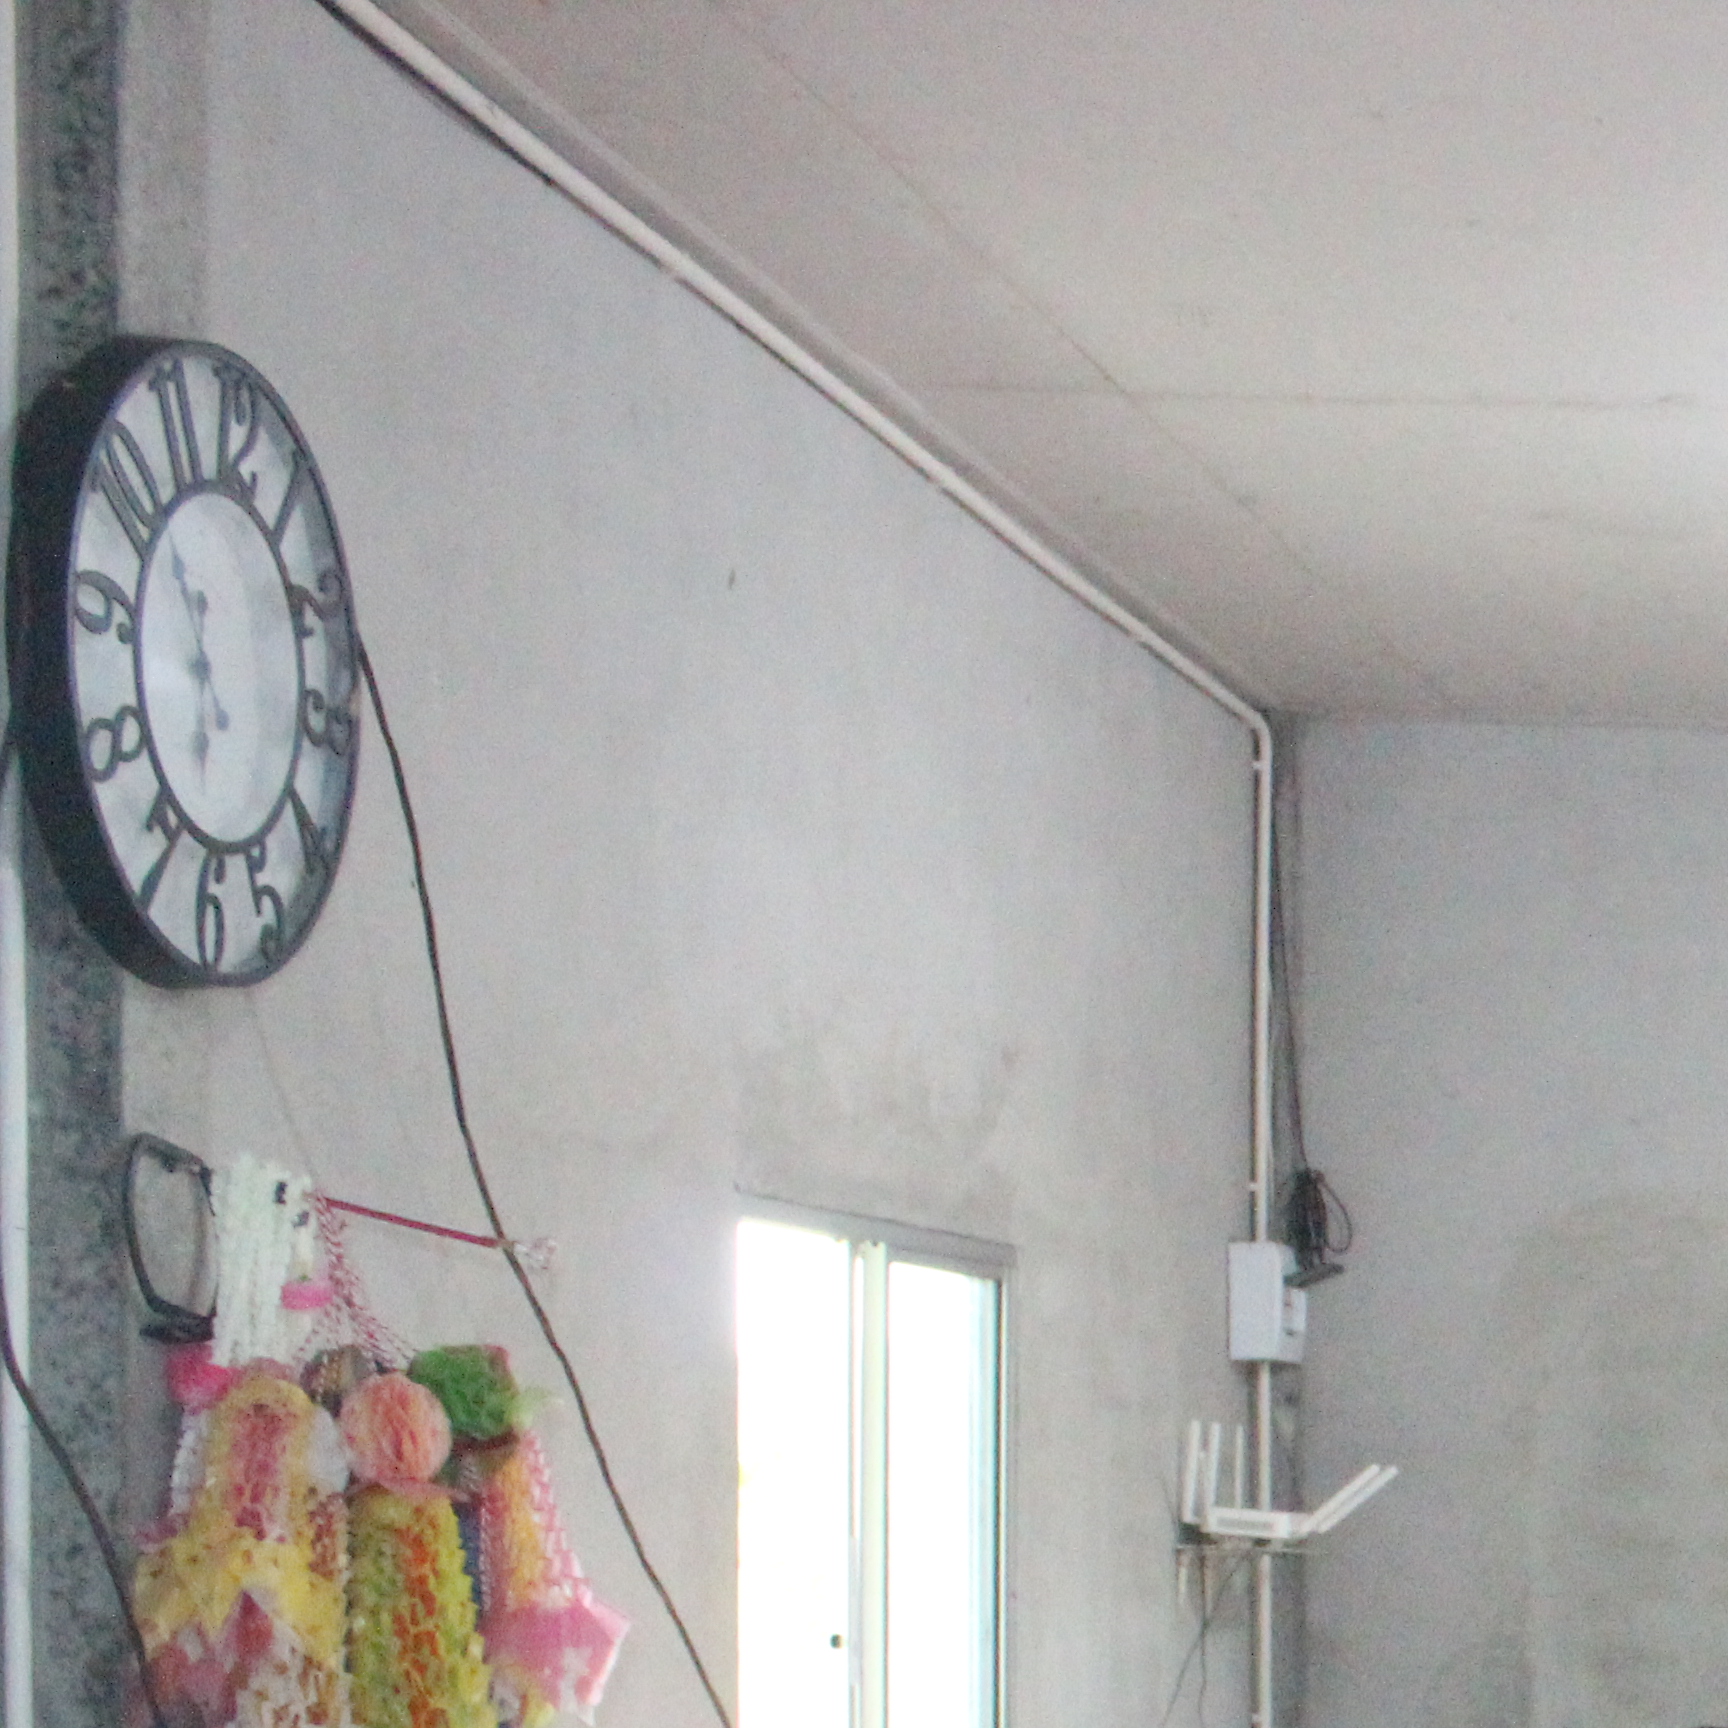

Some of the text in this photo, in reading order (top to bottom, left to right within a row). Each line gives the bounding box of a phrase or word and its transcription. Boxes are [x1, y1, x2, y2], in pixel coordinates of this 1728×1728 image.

[73, 568, 135, 646] 9
[85, 704, 146, 783] 8
[196, 852, 227, 973] 6
